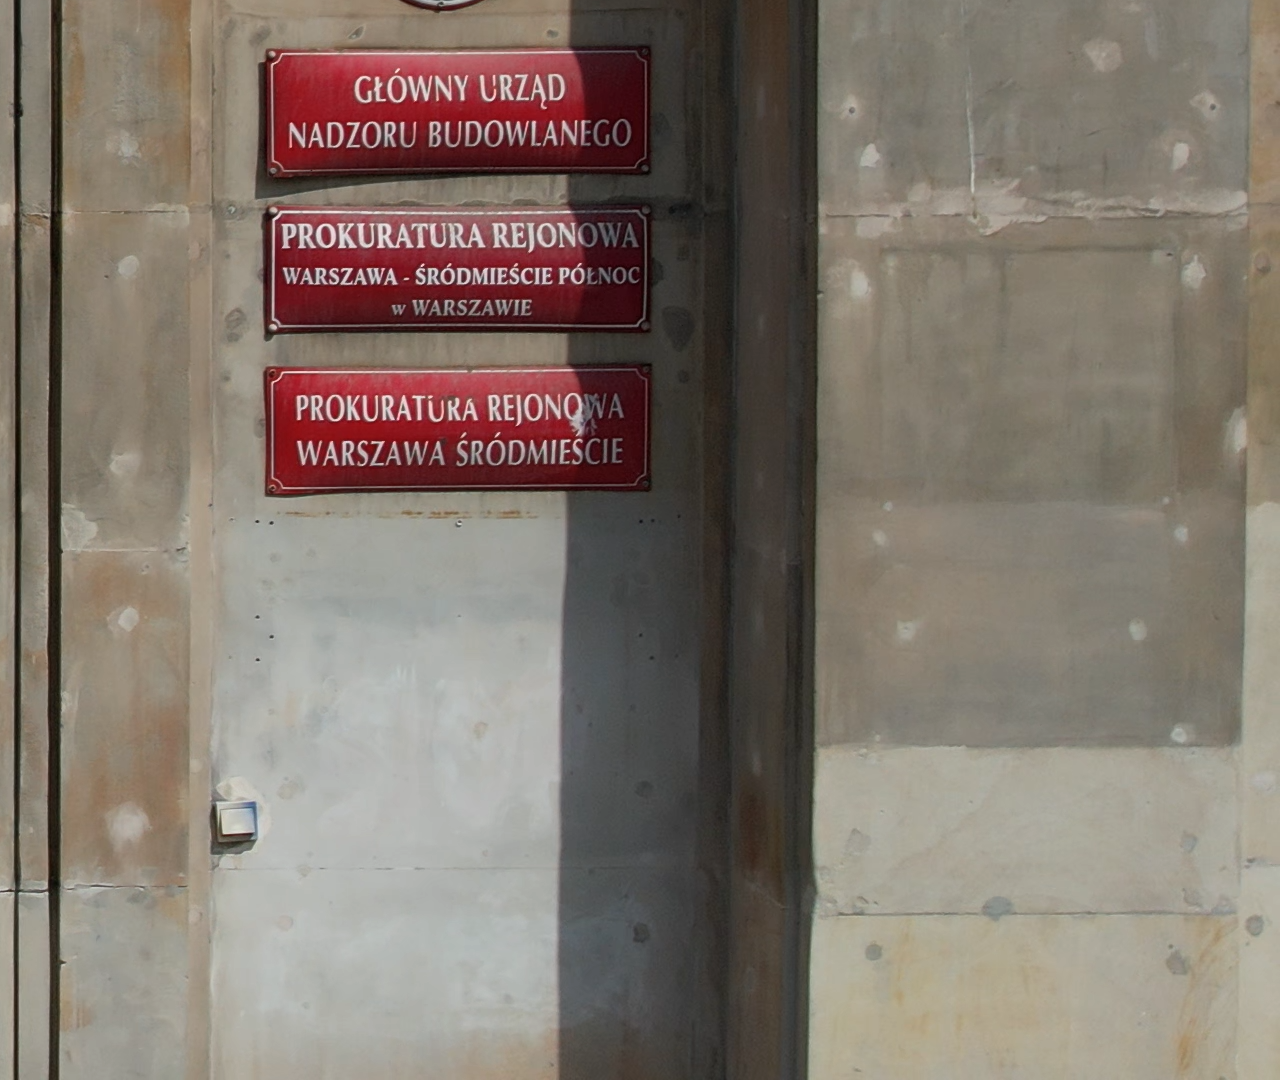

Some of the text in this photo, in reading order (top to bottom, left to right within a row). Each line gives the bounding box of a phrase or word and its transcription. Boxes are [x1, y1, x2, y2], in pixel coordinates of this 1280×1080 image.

[354, 68, 566, 110] GŁÓWNY URZĄD
[288, 118, 633, 149] NADZORU BUDOWLANEGO
[281, 222, 640, 253] PROKURATURA REJONOWA
[282, 266, 399, 287] WARSZAWA
[415, 263, 553, 287] ŚRÓDMIEŚCIE
[558, 263, 640, 286] PÓŁNOC
[391, 299, 533, 317] w WARSZAWIE
[296, 392, 625, 427] PROKURATURA REJONOWA
[297, 431, 624, 468] WARSZAWA ŚRÓDMIEŚCIE
